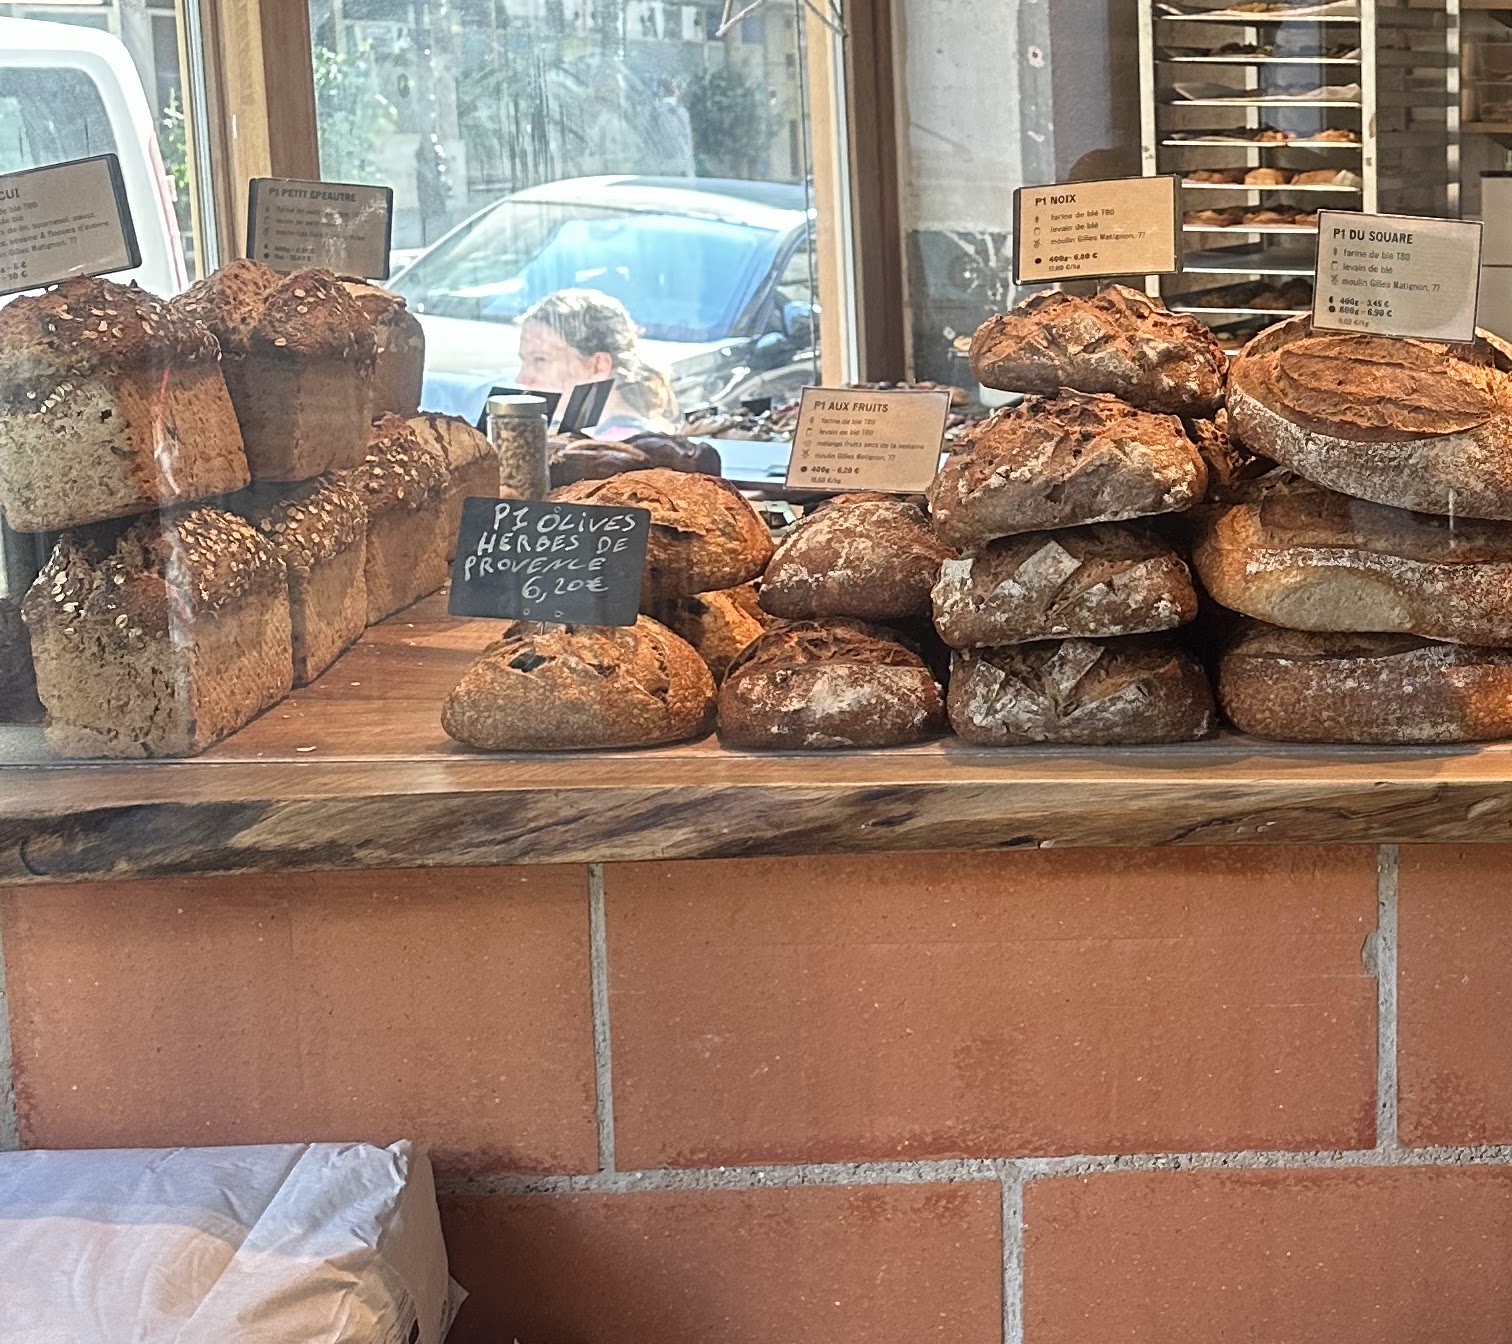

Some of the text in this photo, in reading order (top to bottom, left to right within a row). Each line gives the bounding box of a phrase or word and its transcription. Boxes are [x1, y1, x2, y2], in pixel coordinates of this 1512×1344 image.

[281, 188, 309, 197] PETIT
[1034, 194, 1077, 206] P1 NOIX
[1333, 228, 1414, 245] P1 DU SQUARE
[1342, 263, 1366, 272] levain
[1368, 264, 1378, 273] de
[814, 400, 889, 413] P1 AUX FRUITS
[476, 531, 629, 556] HERBES DE
[464, 555, 607, 582] PROVENCE
[521, 575, 609, 604] 6,20€
